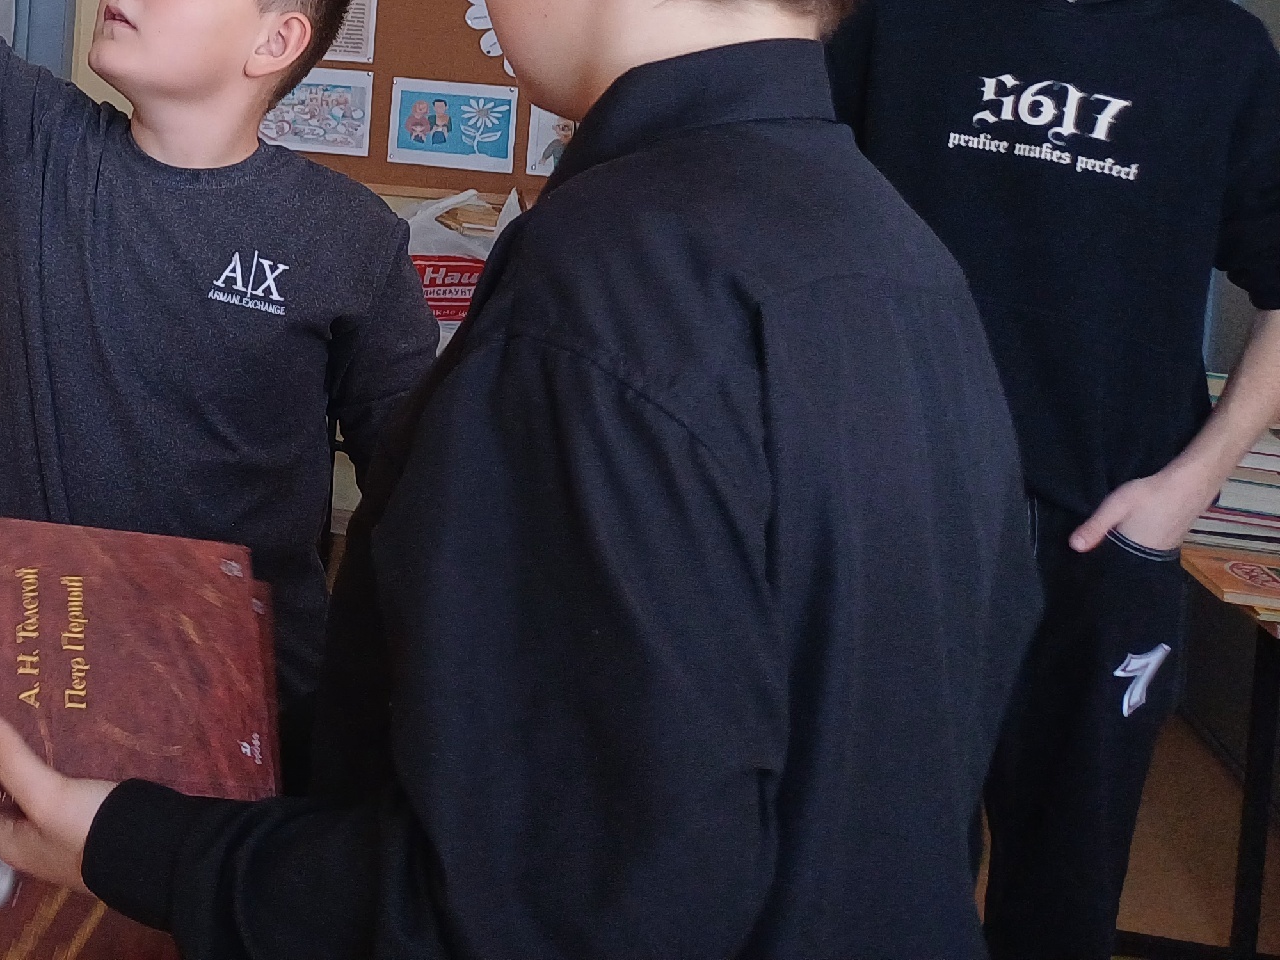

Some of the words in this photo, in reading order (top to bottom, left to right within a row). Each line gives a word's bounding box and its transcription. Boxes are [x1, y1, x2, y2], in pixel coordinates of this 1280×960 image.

[1013, 142, 1072, 165] makes
[1075, 154, 1141, 182] perfect
[14, 567, 40, 644] Толстой
[60, 575, 89, 651] Первый
[16, 649, 40, 675] Н.
[64, 657, 91, 709] Петр
[18, 681, 40, 709] А.
